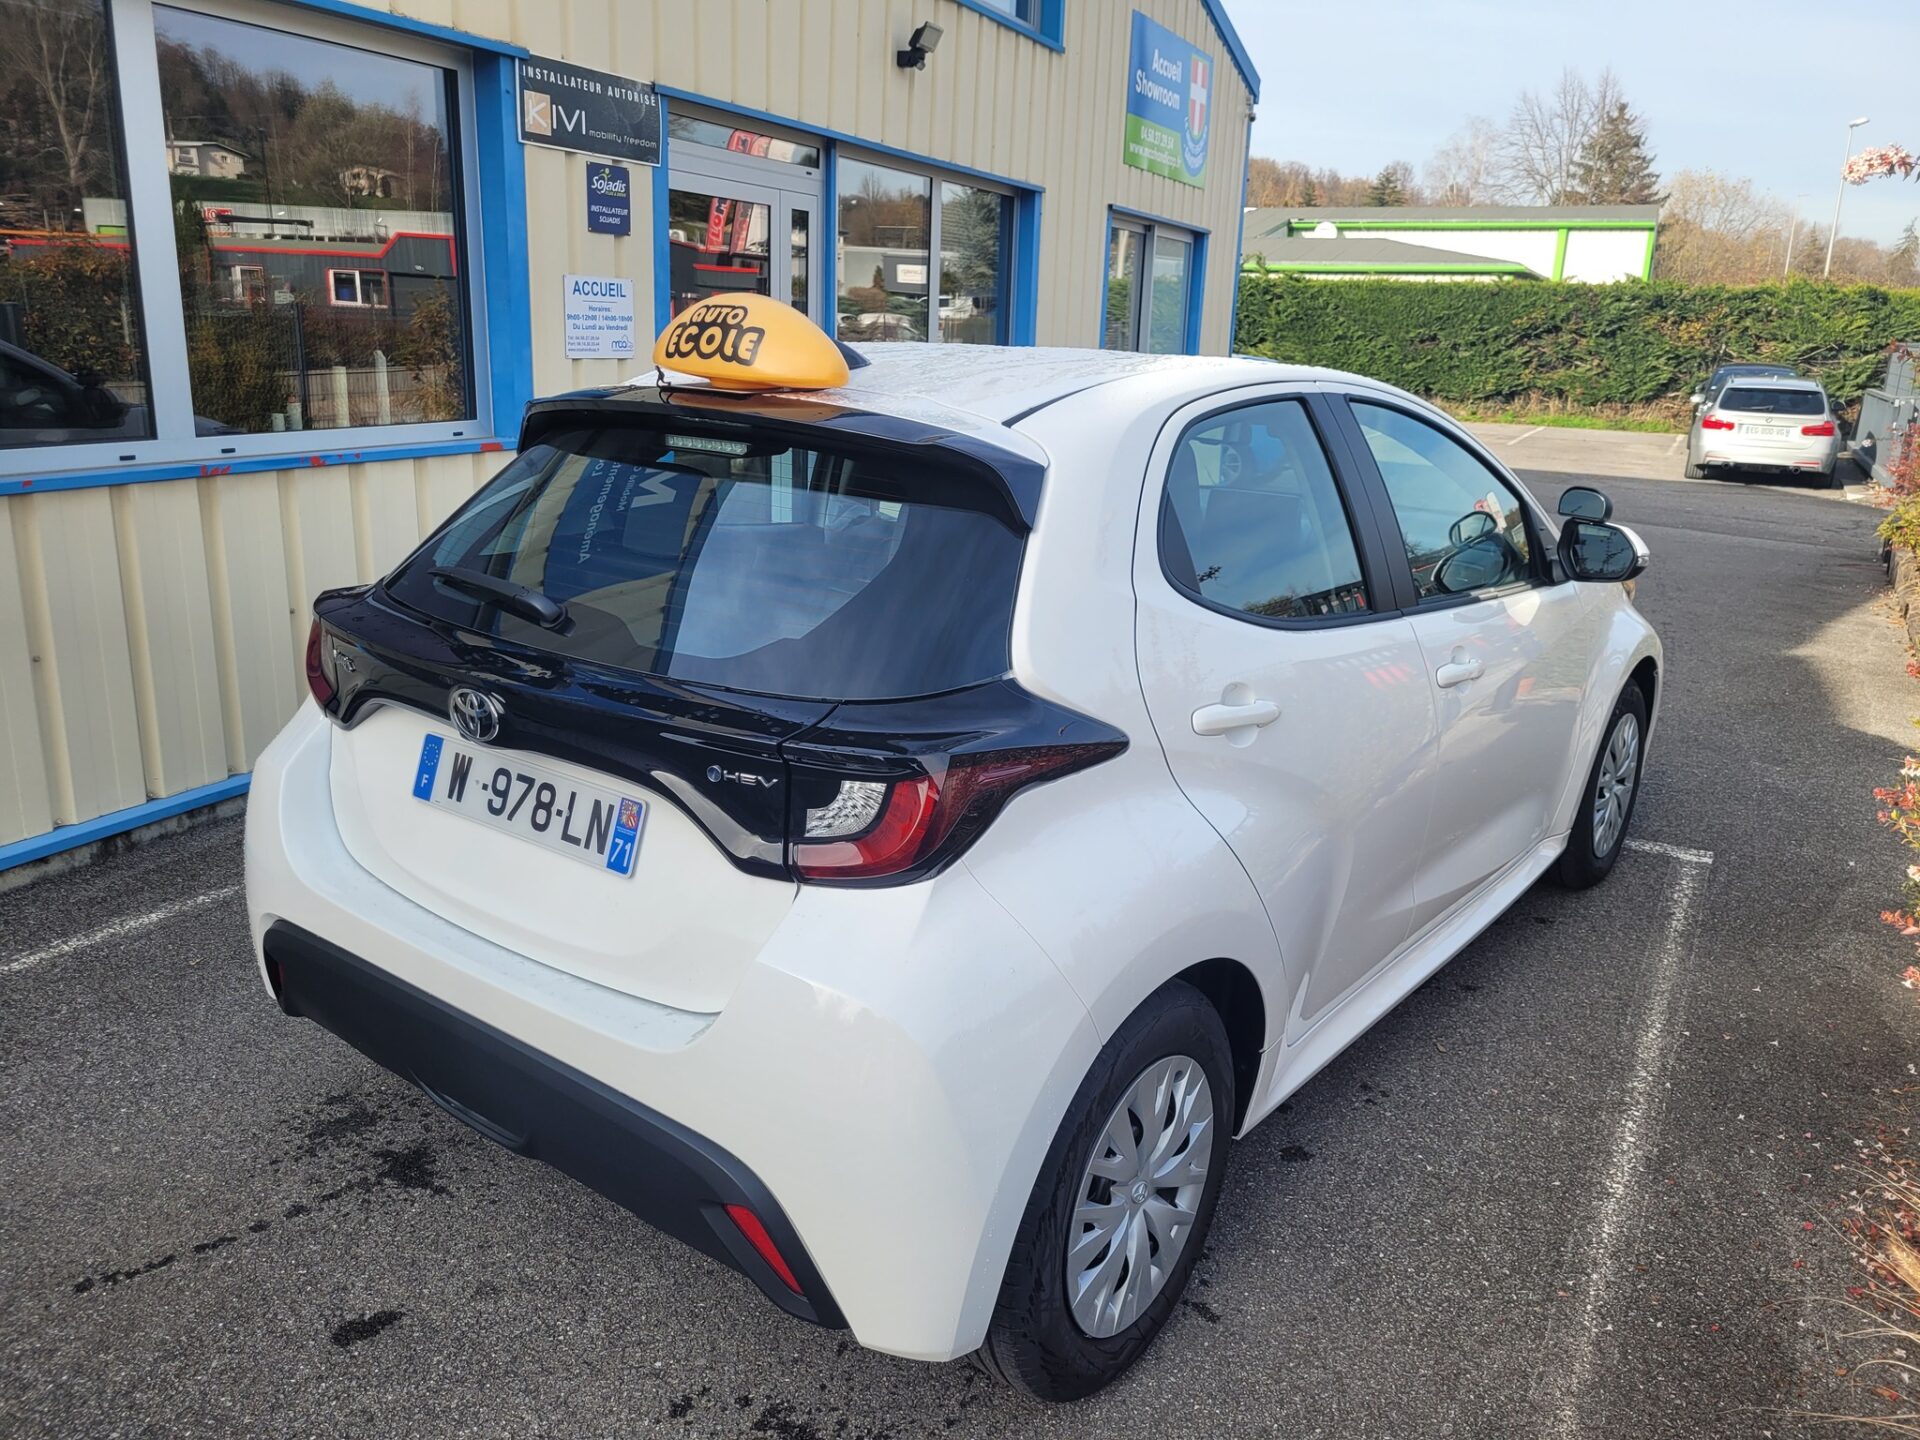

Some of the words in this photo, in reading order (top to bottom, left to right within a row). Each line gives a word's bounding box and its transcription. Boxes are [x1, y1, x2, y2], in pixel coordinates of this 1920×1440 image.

[1152, 49, 1182, 83] Accueil
[523, 65, 601, 94] INSTALLATEUR
[1136, 69, 1180, 110] Showroom
[527, 99, 586, 136] KIVI
[589, 129, 621, 143] mobility
[624, 136, 657, 149] freedom
[592, 175, 627, 193] Sojadis
[591, 205, 628, 216] INSTALLATEUR
[599, 216, 621, 225] SOJADIS
[573, 281, 627, 298] ACCUEIL
[692, 307, 745, 325] AUTO
[420, 774, 429, 788] F
[723, 770, 779, 788] HEV
[610, 838, 633, 868] 71
